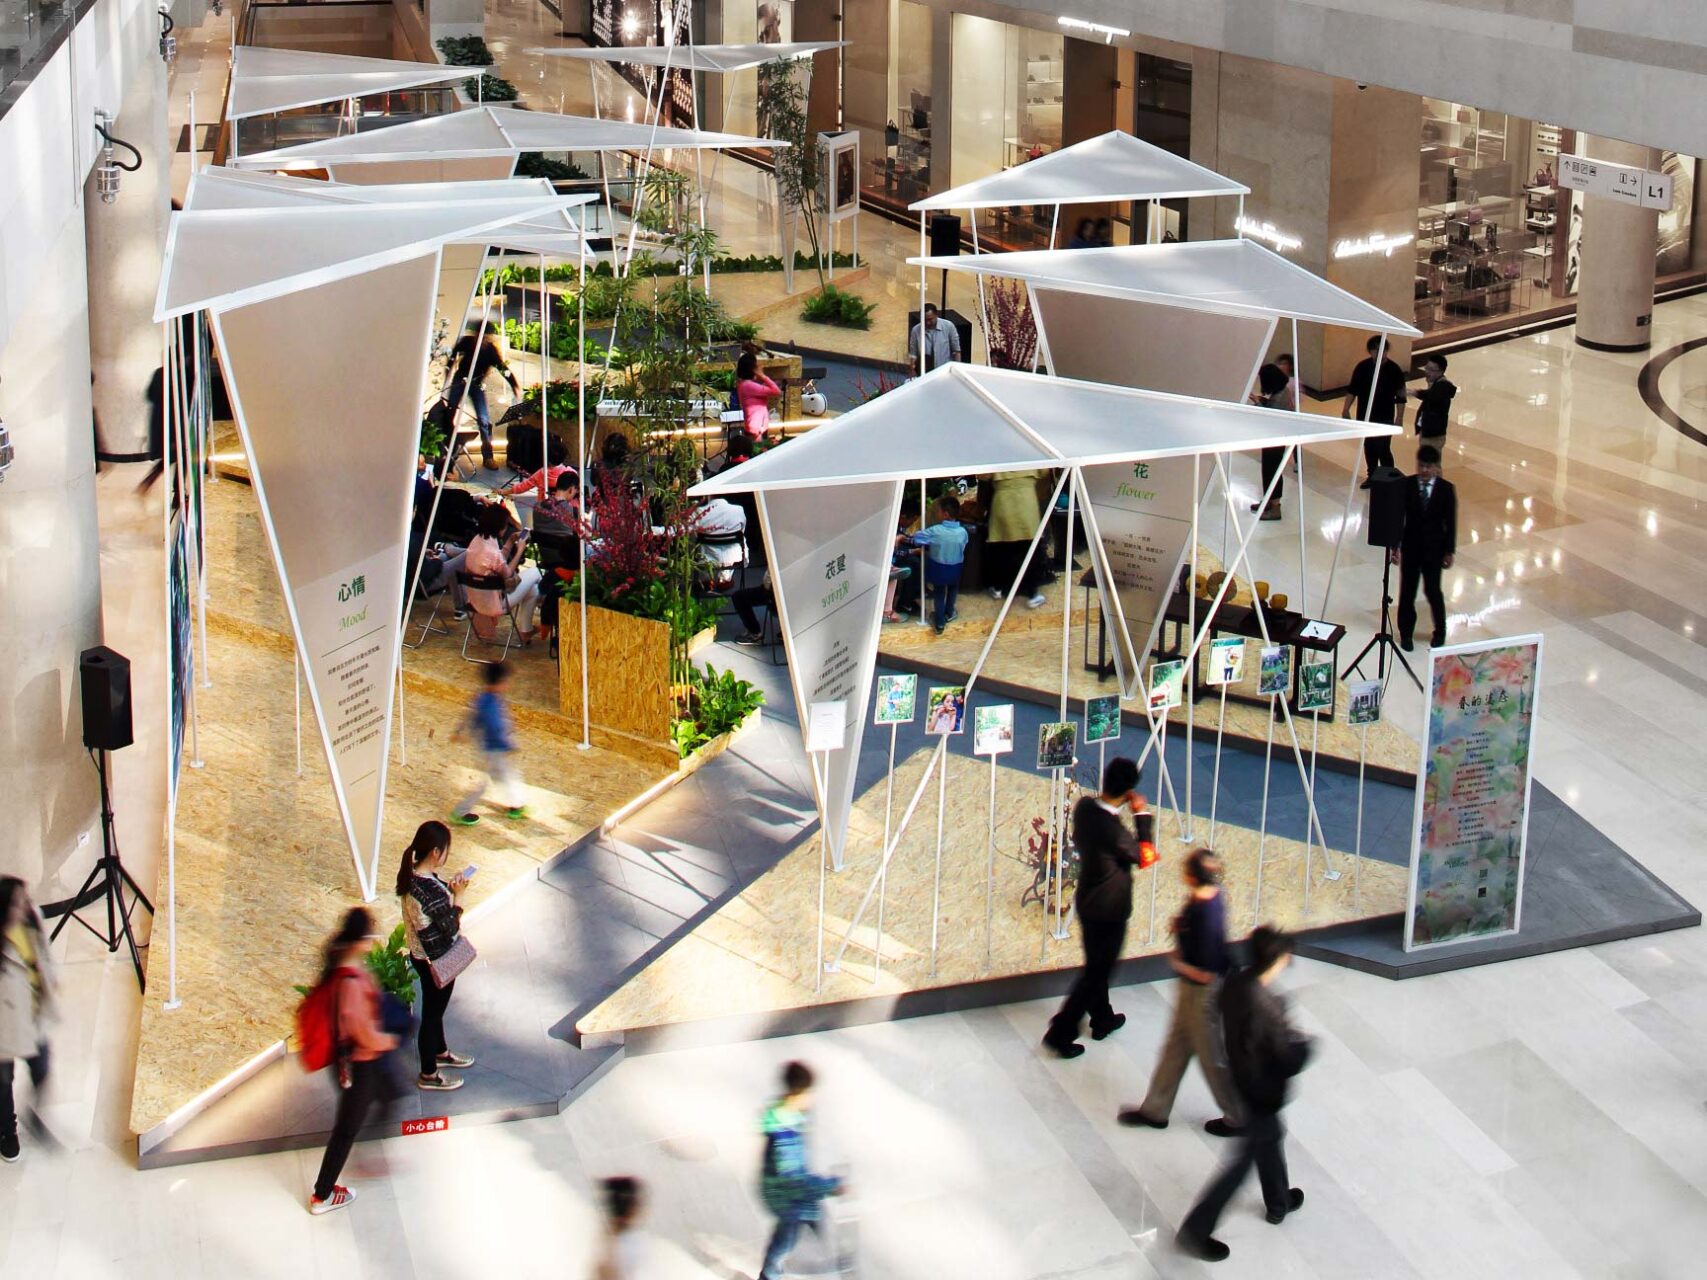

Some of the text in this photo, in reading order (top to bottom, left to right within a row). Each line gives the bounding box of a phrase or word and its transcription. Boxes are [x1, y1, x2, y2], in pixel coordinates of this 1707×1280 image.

[1648, 185, 1664, 199] L1
[1133, 461, 1149, 479] 花
[1112, 481, 1157, 501] flower
[337, 575, 366, 602] 心情
[338, 604, 369, 632] Mood
